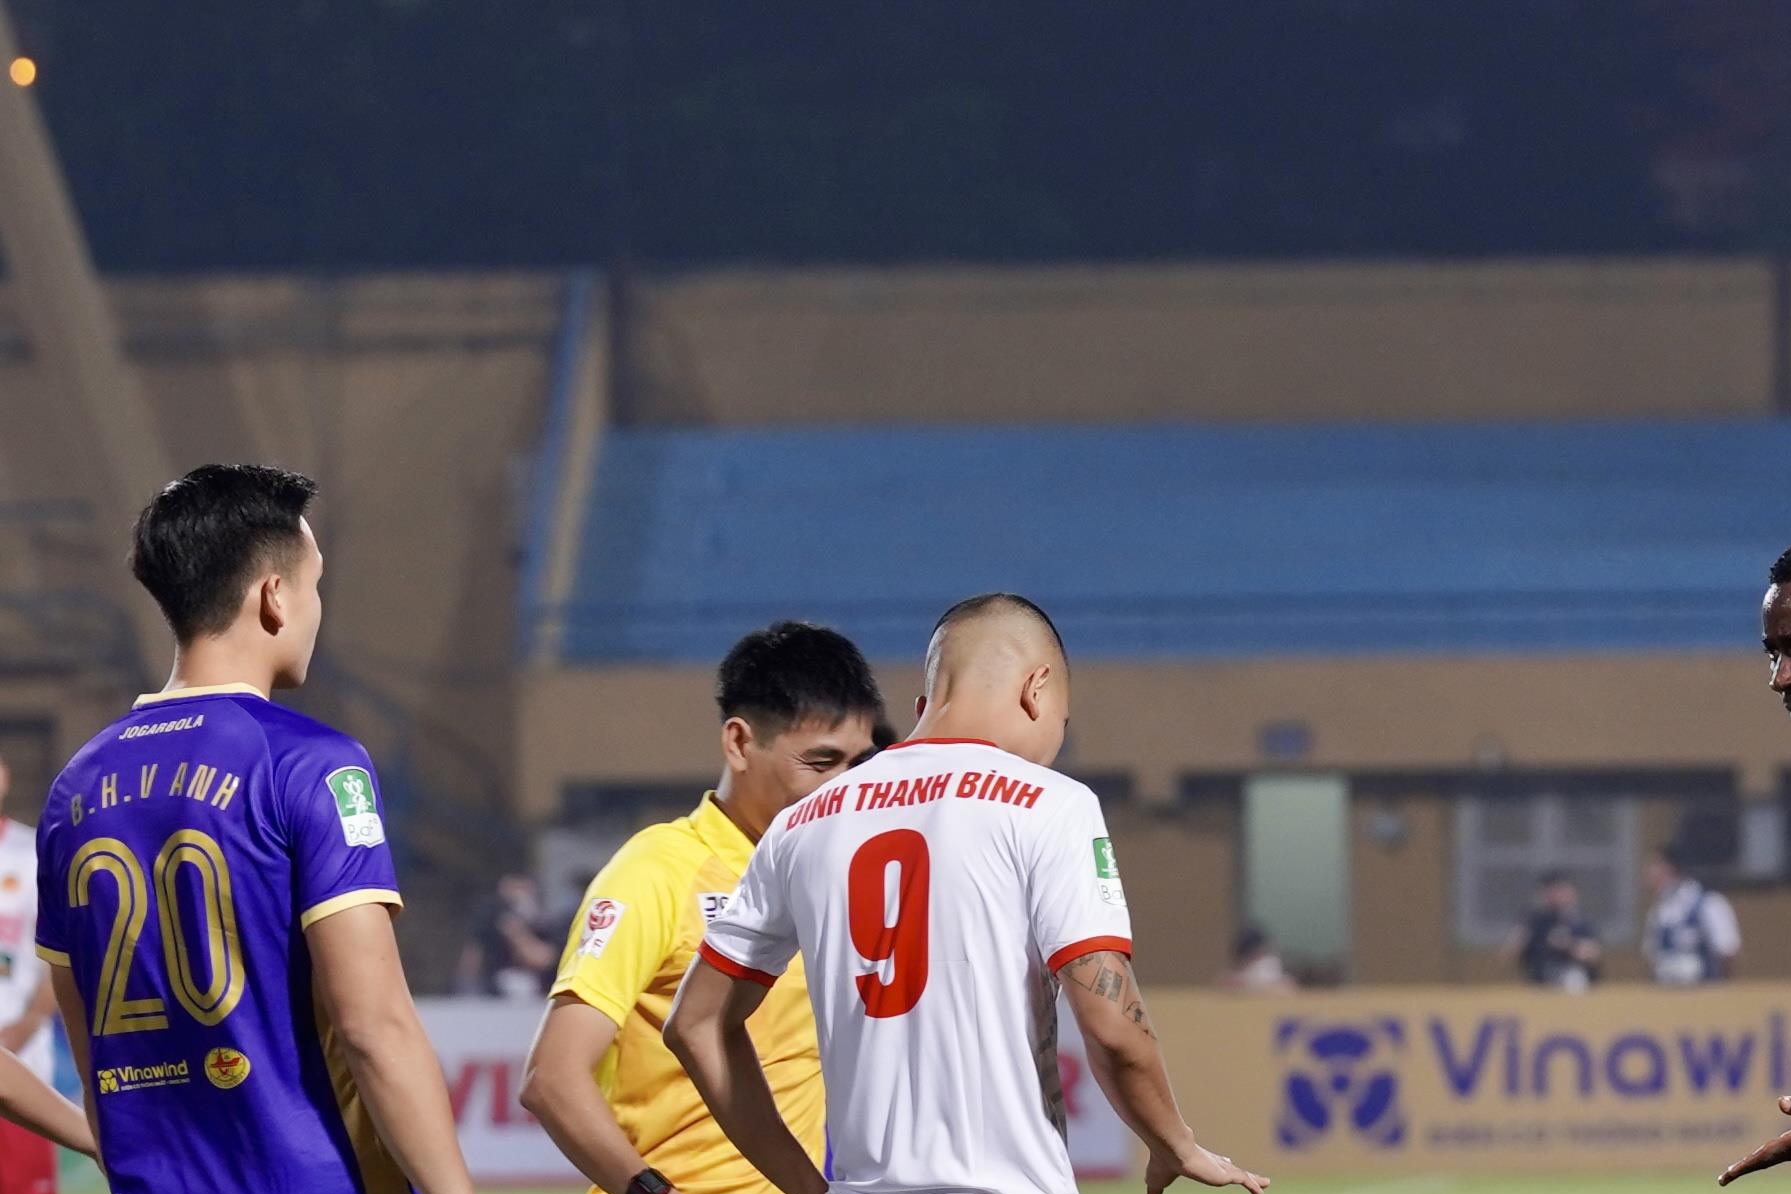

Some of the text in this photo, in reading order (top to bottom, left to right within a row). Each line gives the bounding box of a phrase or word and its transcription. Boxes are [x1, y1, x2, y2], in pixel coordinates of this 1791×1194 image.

[118, 714, 205, 740] JOGARBOLA
[168, 761, 240, 811] ANH
[854, 772, 952, 812] THANH
[955, 769, 1045, 810] BÌNH
[68, 828, 246, 1037] 20
[848, 828, 930, 1018] 9
[117, 1060, 189, 1082] Vinawind
